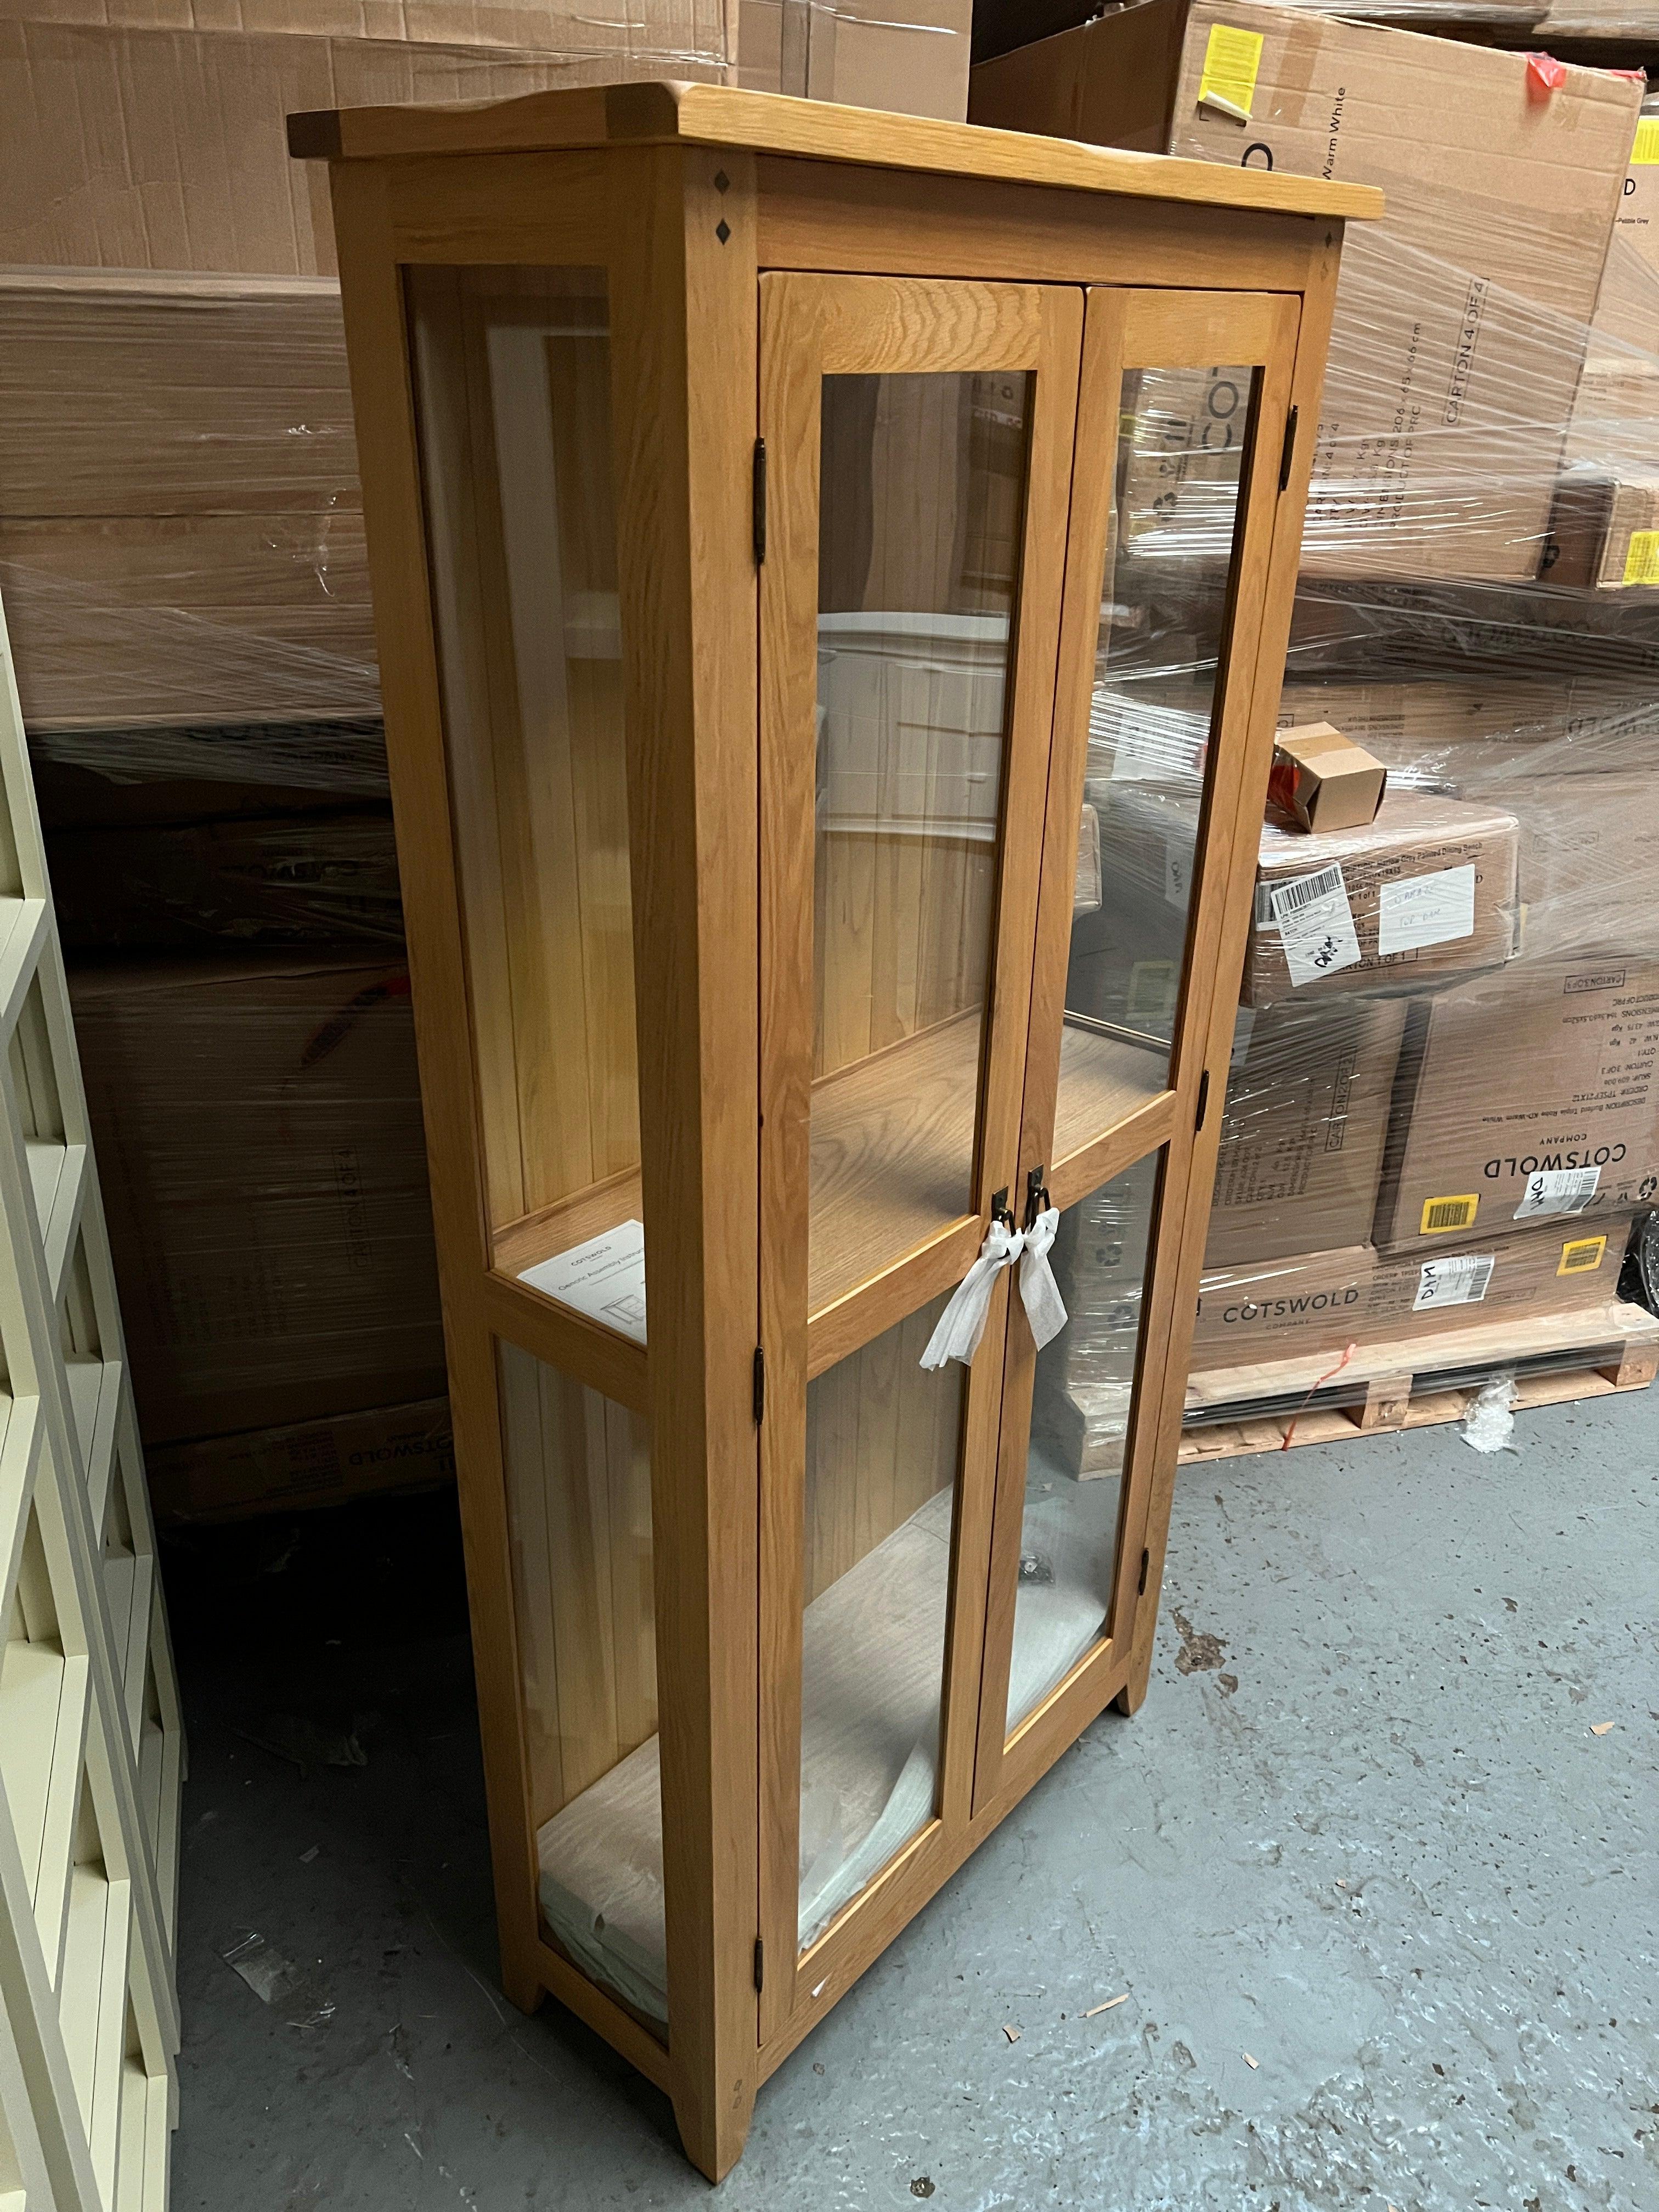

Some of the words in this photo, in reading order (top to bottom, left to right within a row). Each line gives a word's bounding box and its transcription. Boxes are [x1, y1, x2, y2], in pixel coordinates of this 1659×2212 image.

[1329, 87, 1346, 133] White
[1474, 282, 1483, 292] 4
[1467, 297, 1480, 324] OF
[1464, 329, 1475, 340] 4
[1392, 408, 1406, 433] 206
[1412, 323, 1421, 342] cm
[1446, 345, 1471, 423] CARTON
[1329, 1095, 1346, 1148] CARON
[1539, 1133, 1587, 1146] COMPANY
[1484, 1143, 1627, 1178] COTSWOLD
[571, 1246, 611, 1267] COTSWOLD
[558, 1275, 588, 1291] Generic
[588, 1259, 621, 1278] Assembly
[1223, 1289, 1359, 1323] COTSWOLD
[1266, 1319, 1311, 1330] COMPANY
